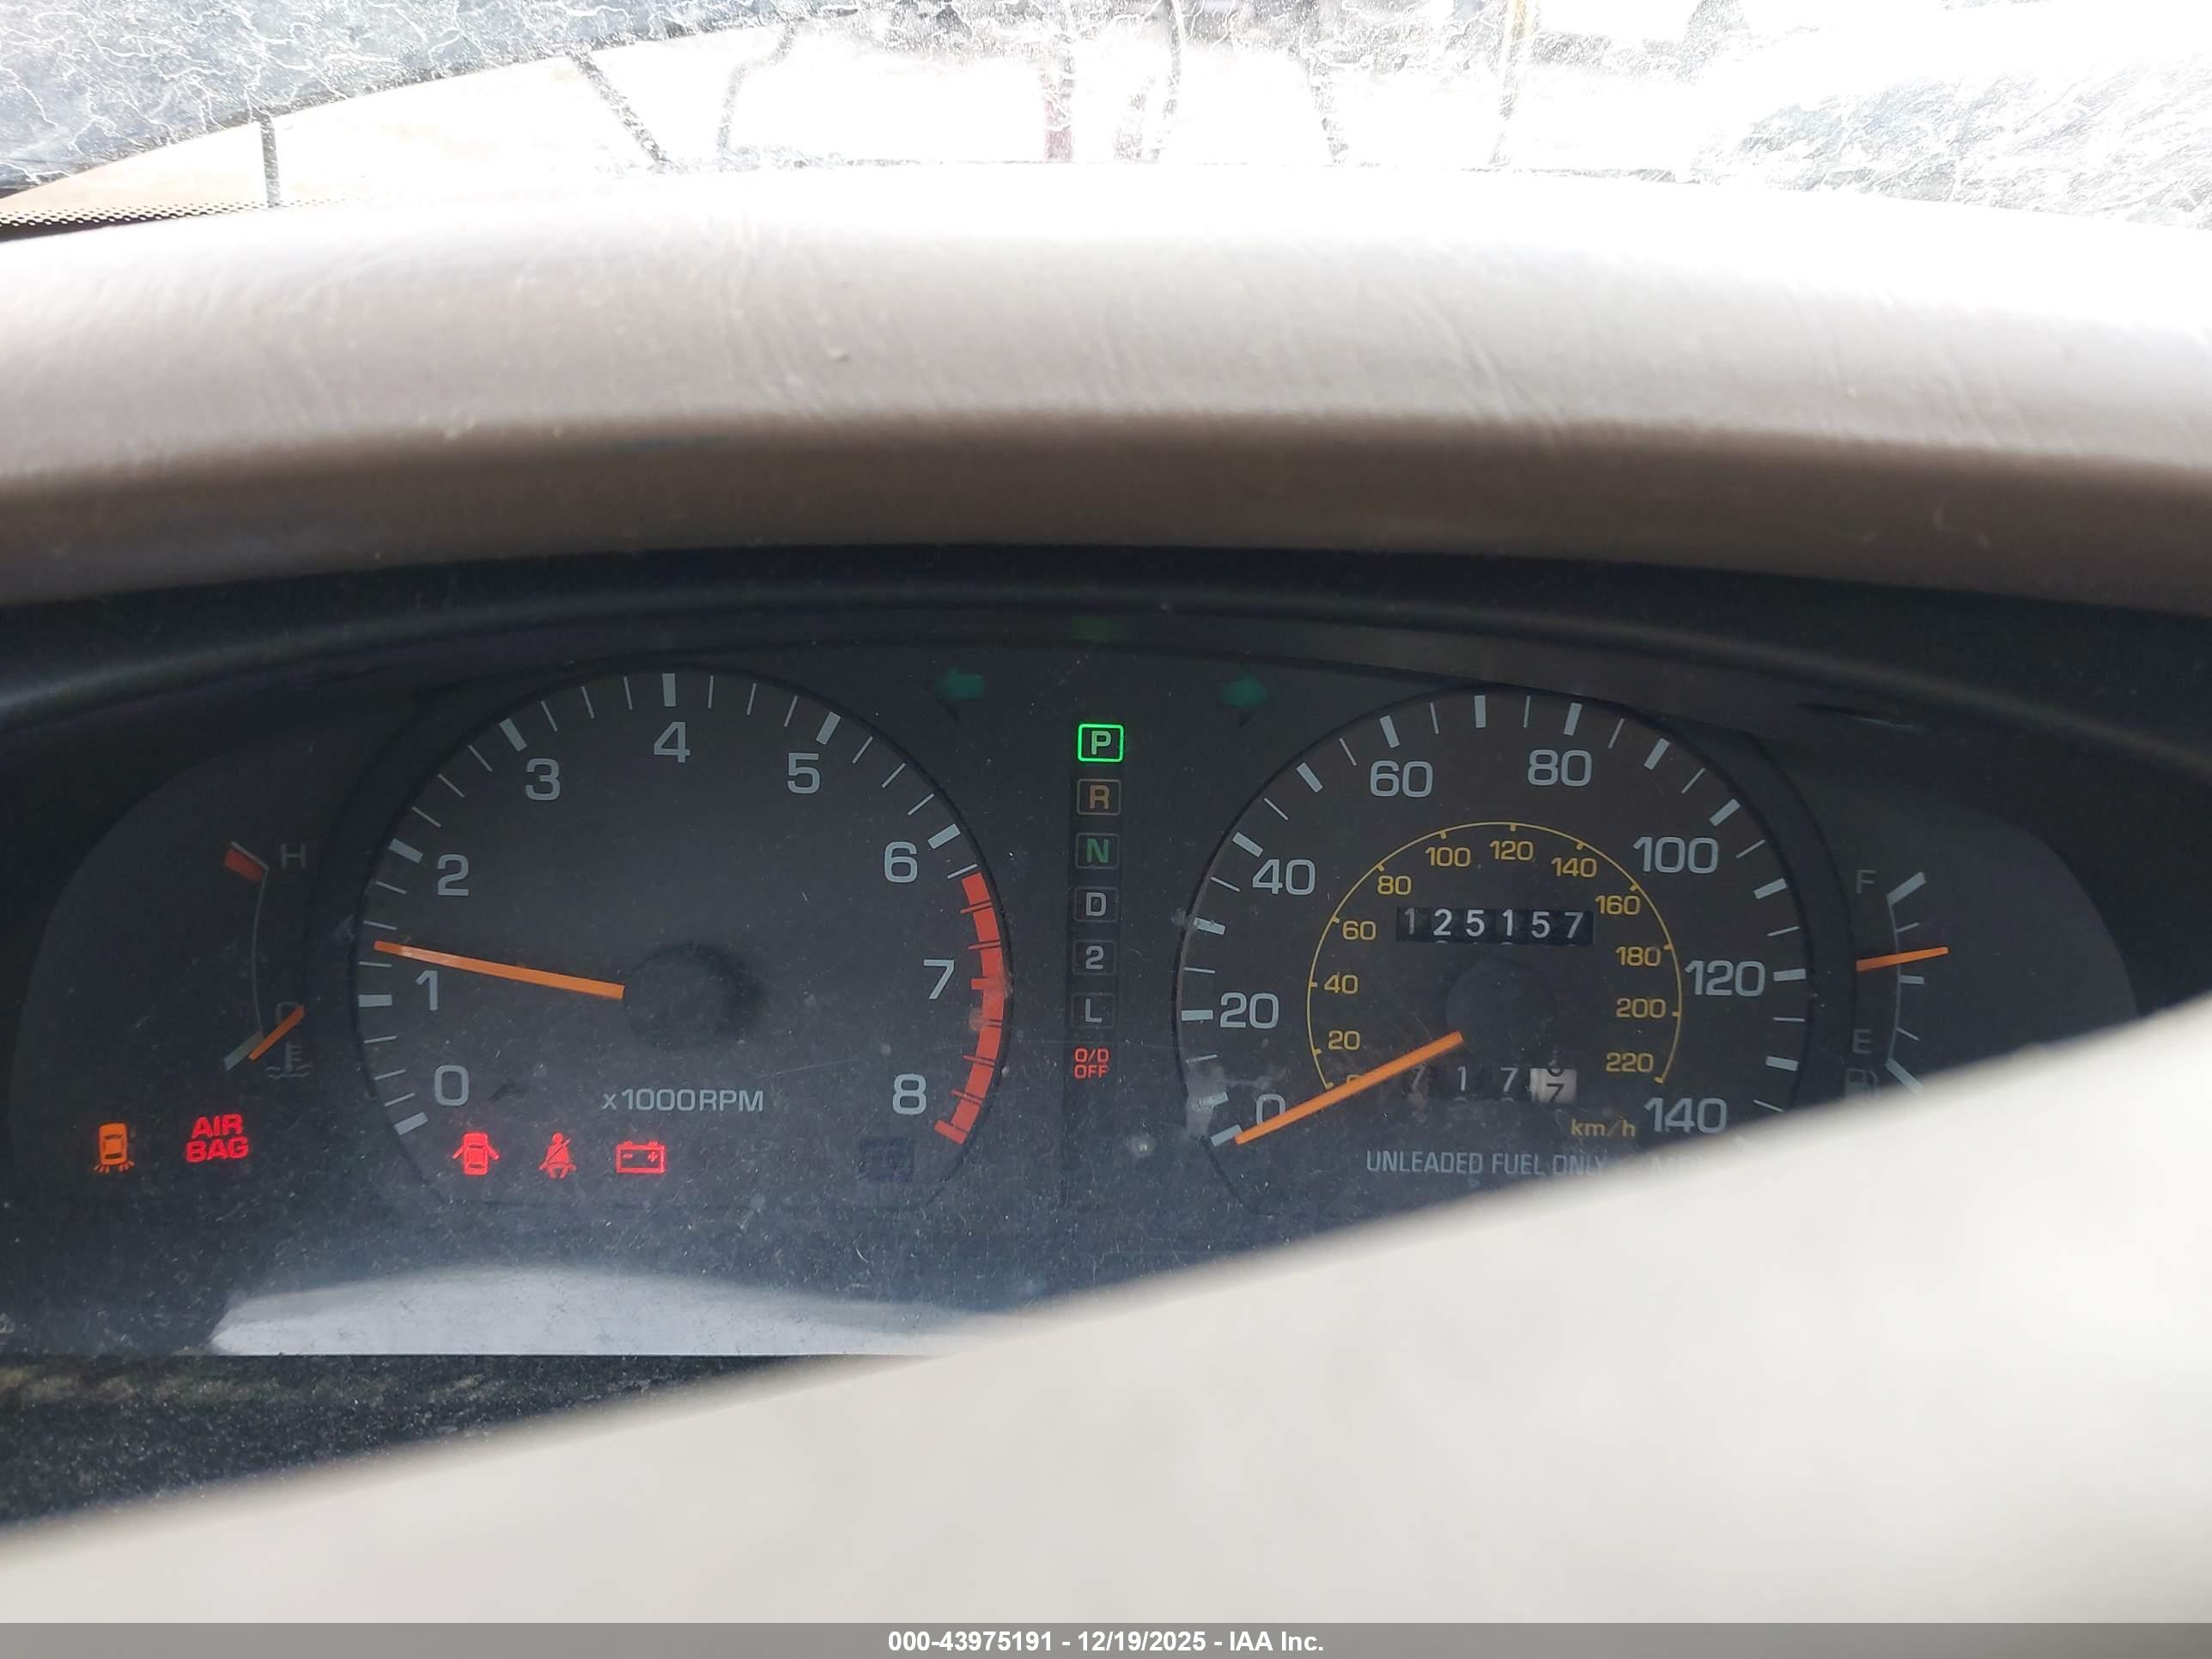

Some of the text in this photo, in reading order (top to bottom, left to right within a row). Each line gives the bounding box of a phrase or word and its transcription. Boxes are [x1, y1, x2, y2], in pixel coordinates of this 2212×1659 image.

[653, 722, 690, 763] 4
[1091, 731, 1111, 756] P
[526, 758, 561, 800] 3
[787, 753, 820, 794] 5
[1370, 761, 1433, 797] 60
[1528, 750, 1592, 786] 80
[1088, 784, 1109, 810] R
[281, 843, 307, 868] H
[884, 842, 918, 883] 6
[1086, 838, 1109, 864] N
[1425, 847, 1471, 867] 100
[1490, 840, 1534, 860] 120
[1634, 837, 1718, 872] 100
[437, 854, 469, 896] 2
[1253, 860, 1316, 894] 40
[1551, 858, 1597, 878] 140
[1377, 876, 1412, 896] 80
[1856, 869, 1876, 894] F
[1086, 892, 1106, 917] D
[1595, 896, 1640, 915] 160
[1342, 921, 1376, 940] 60
[1404, 908, 1583, 939] 125157
[1085, 946, 1104, 969] 2
[1615, 946, 1662, 966] 180
[416, 971, 439, 1011] 1
[924, 960, 955, 1000] 7
[1324, 975, 1359, 994] 40
[1685, 961, 1765, 997] 120
[1085, 1000, 1102, 1023] L
[1220, 993, 1279, 1029] 20
[1615, 999, 1666, 1019] 200
[1328, 1031, 1360, 1050] 20
[1852, 1030, 1871, 1054] E
[1074, 1048, 1109, 1063] O/D
[1606, 1052, 1654, 1073] 220
[1074, 1065, 1109, 1079] OFF
[434, 1066, 469, 1106] 0
[892, 1073, 927, 1115] 8
[191, 1114, 244, 1139] AIR
[1644, 1097, 1728, 1133] 140
[1571, 1119, 1636, 1137] km/h
[185, 1137, 249, 1163] BAG
[1366, 1151, 1606, 1176] UNLEADED FUEL ONLY
